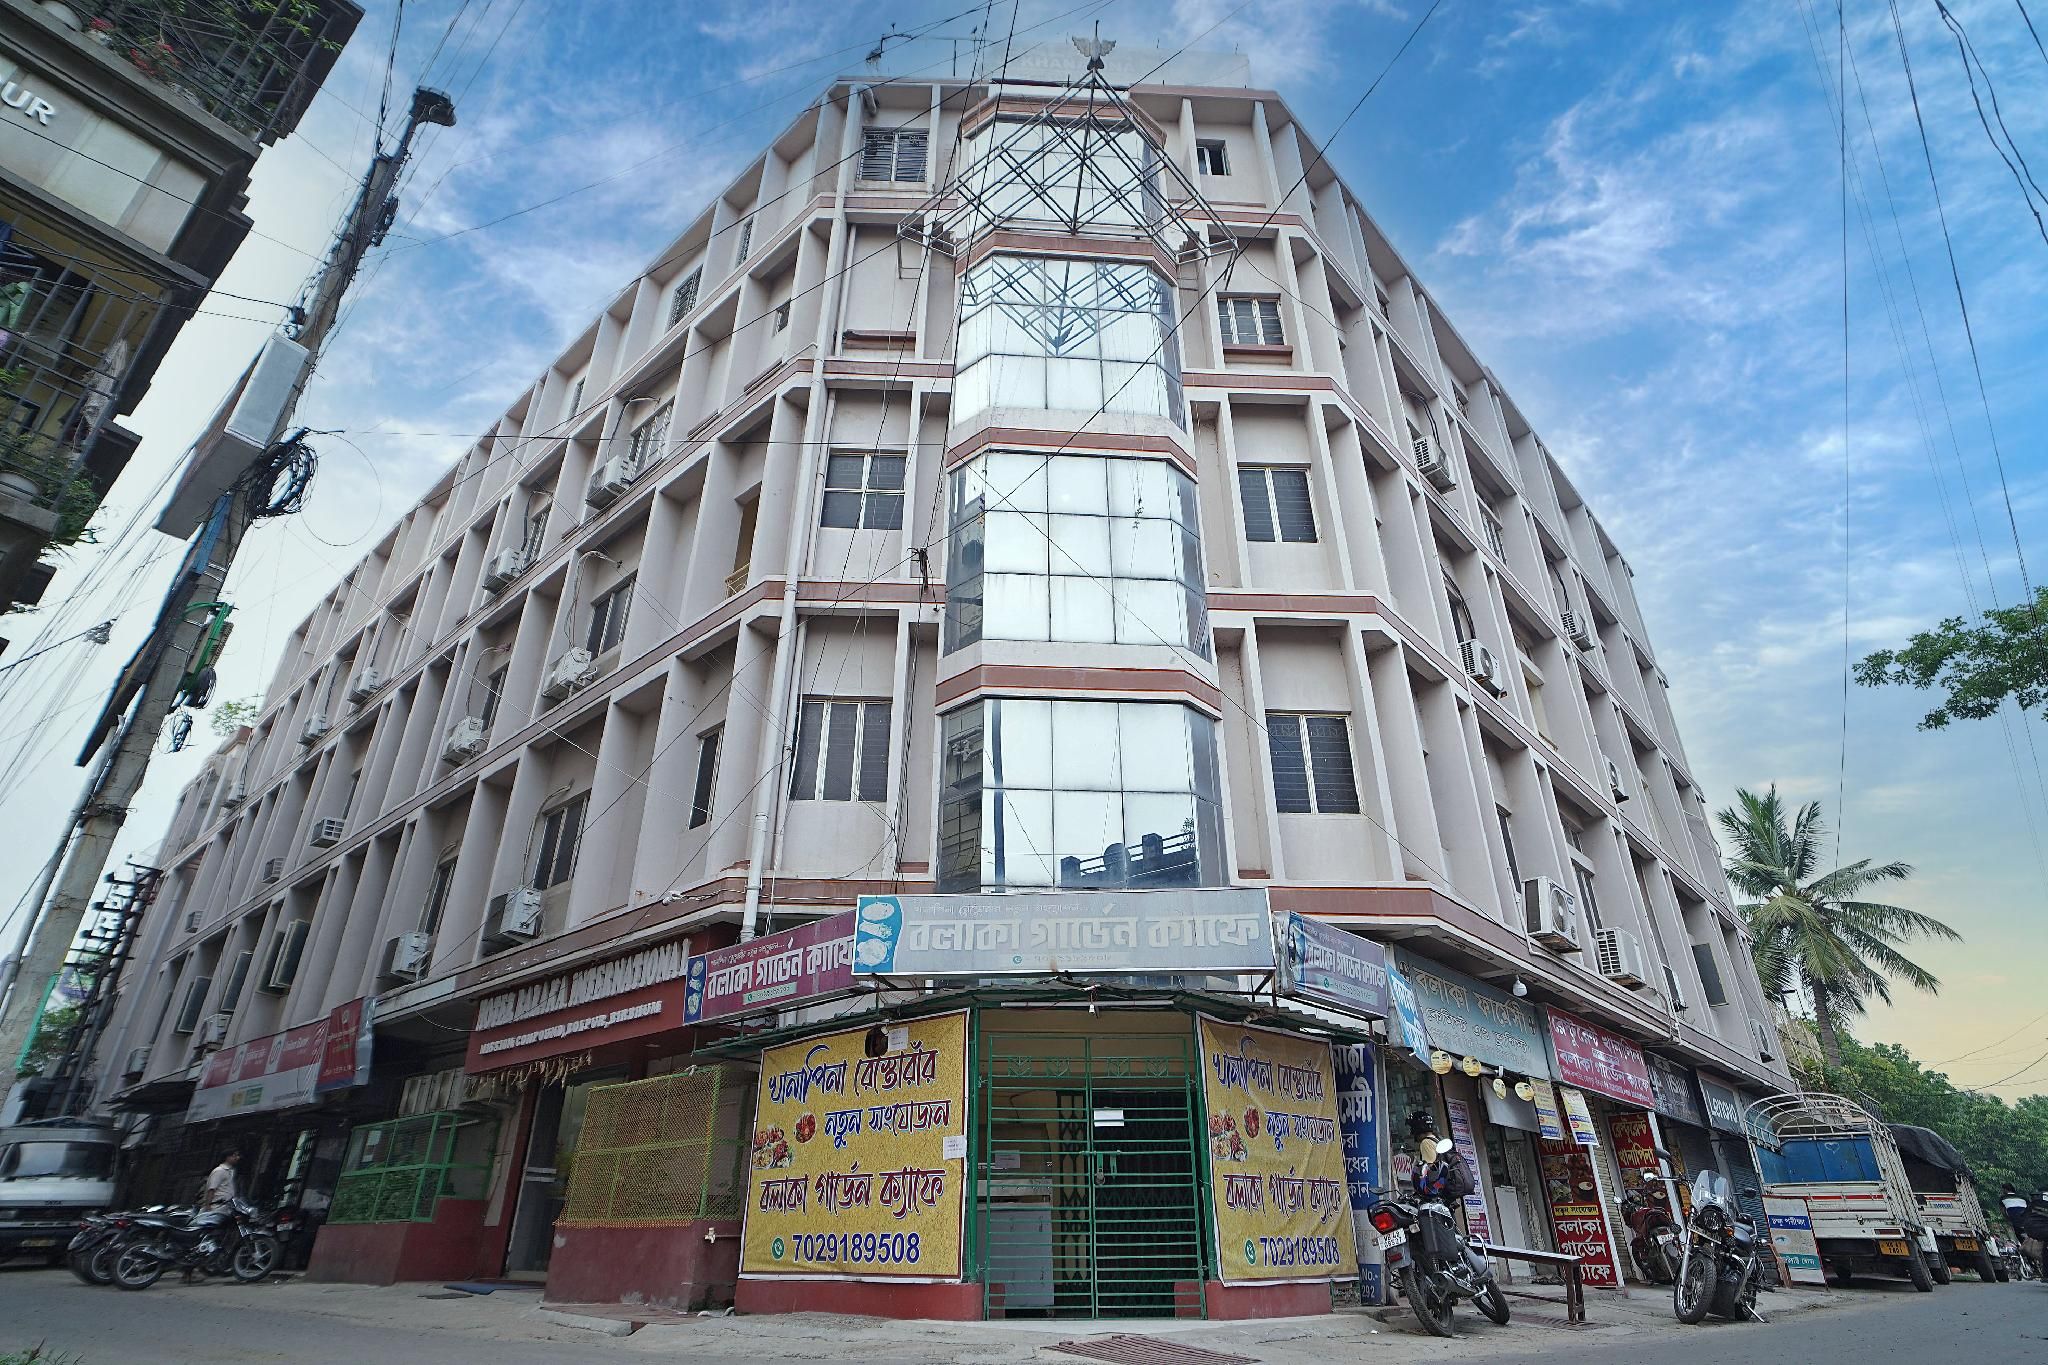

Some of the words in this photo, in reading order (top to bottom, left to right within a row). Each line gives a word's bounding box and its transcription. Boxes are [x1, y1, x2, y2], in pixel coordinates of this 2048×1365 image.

[0, 75, 56, 126] UR
[908, 919, 1022, 951] বলাকা
[568, 938, 692, 1007] INTERNATIONAL
[708, 961, 754, 999] বলাকা
[768, 1044, 847, 1104] খানাপিনা
[1212, 1035, 1274, 1097] খানাপিনা
[1333, 1044, 1366, 1074] লাকা
[824, 1109, 863, 1149] নতুন
[868, 1100, 951, 1137] সংযোজন
[1265, 1111, 1290, 1151] নতুন
[760, 1173, 810, 1213] বলাকা
[815, 1161, 873, 1215] গার্ডেন
[879, 1166, 947, 1219] ক্যাফে
[1223, 1173, 1266, 1214] বলাকা
[1555, 1218, 1602, 1235] বলাকা
[1560, 1234, 1607, 1257] গার্ডেন
[792, 1232, 921, 1264] 7029189508
[1260, 1236, 1340, 1266] 7029189508
